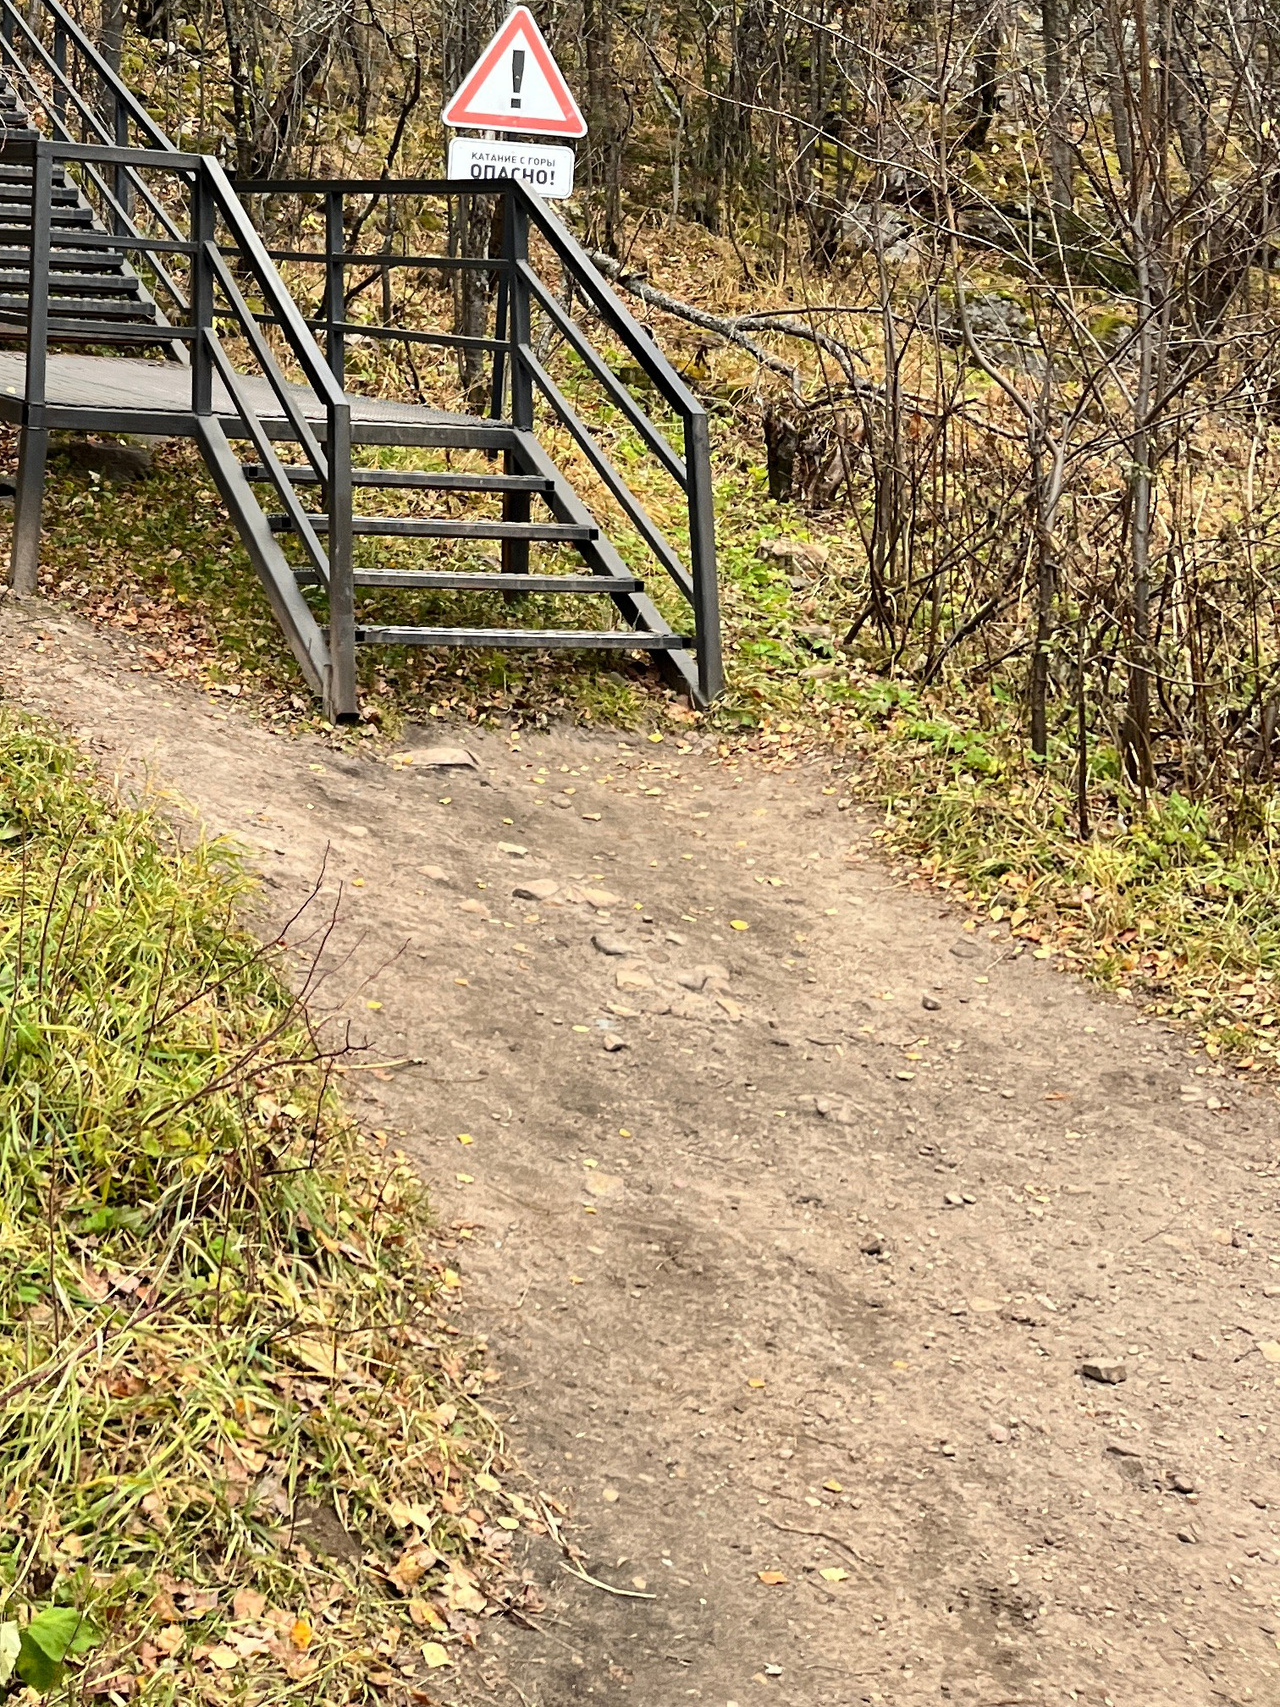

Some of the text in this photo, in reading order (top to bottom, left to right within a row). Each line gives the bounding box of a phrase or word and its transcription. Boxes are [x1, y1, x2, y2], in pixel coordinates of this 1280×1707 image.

[471, 151, 556, 167] КАТАНИЕ С ГОРЫ
[470, 163, 556, 186] ОПАСНО!
